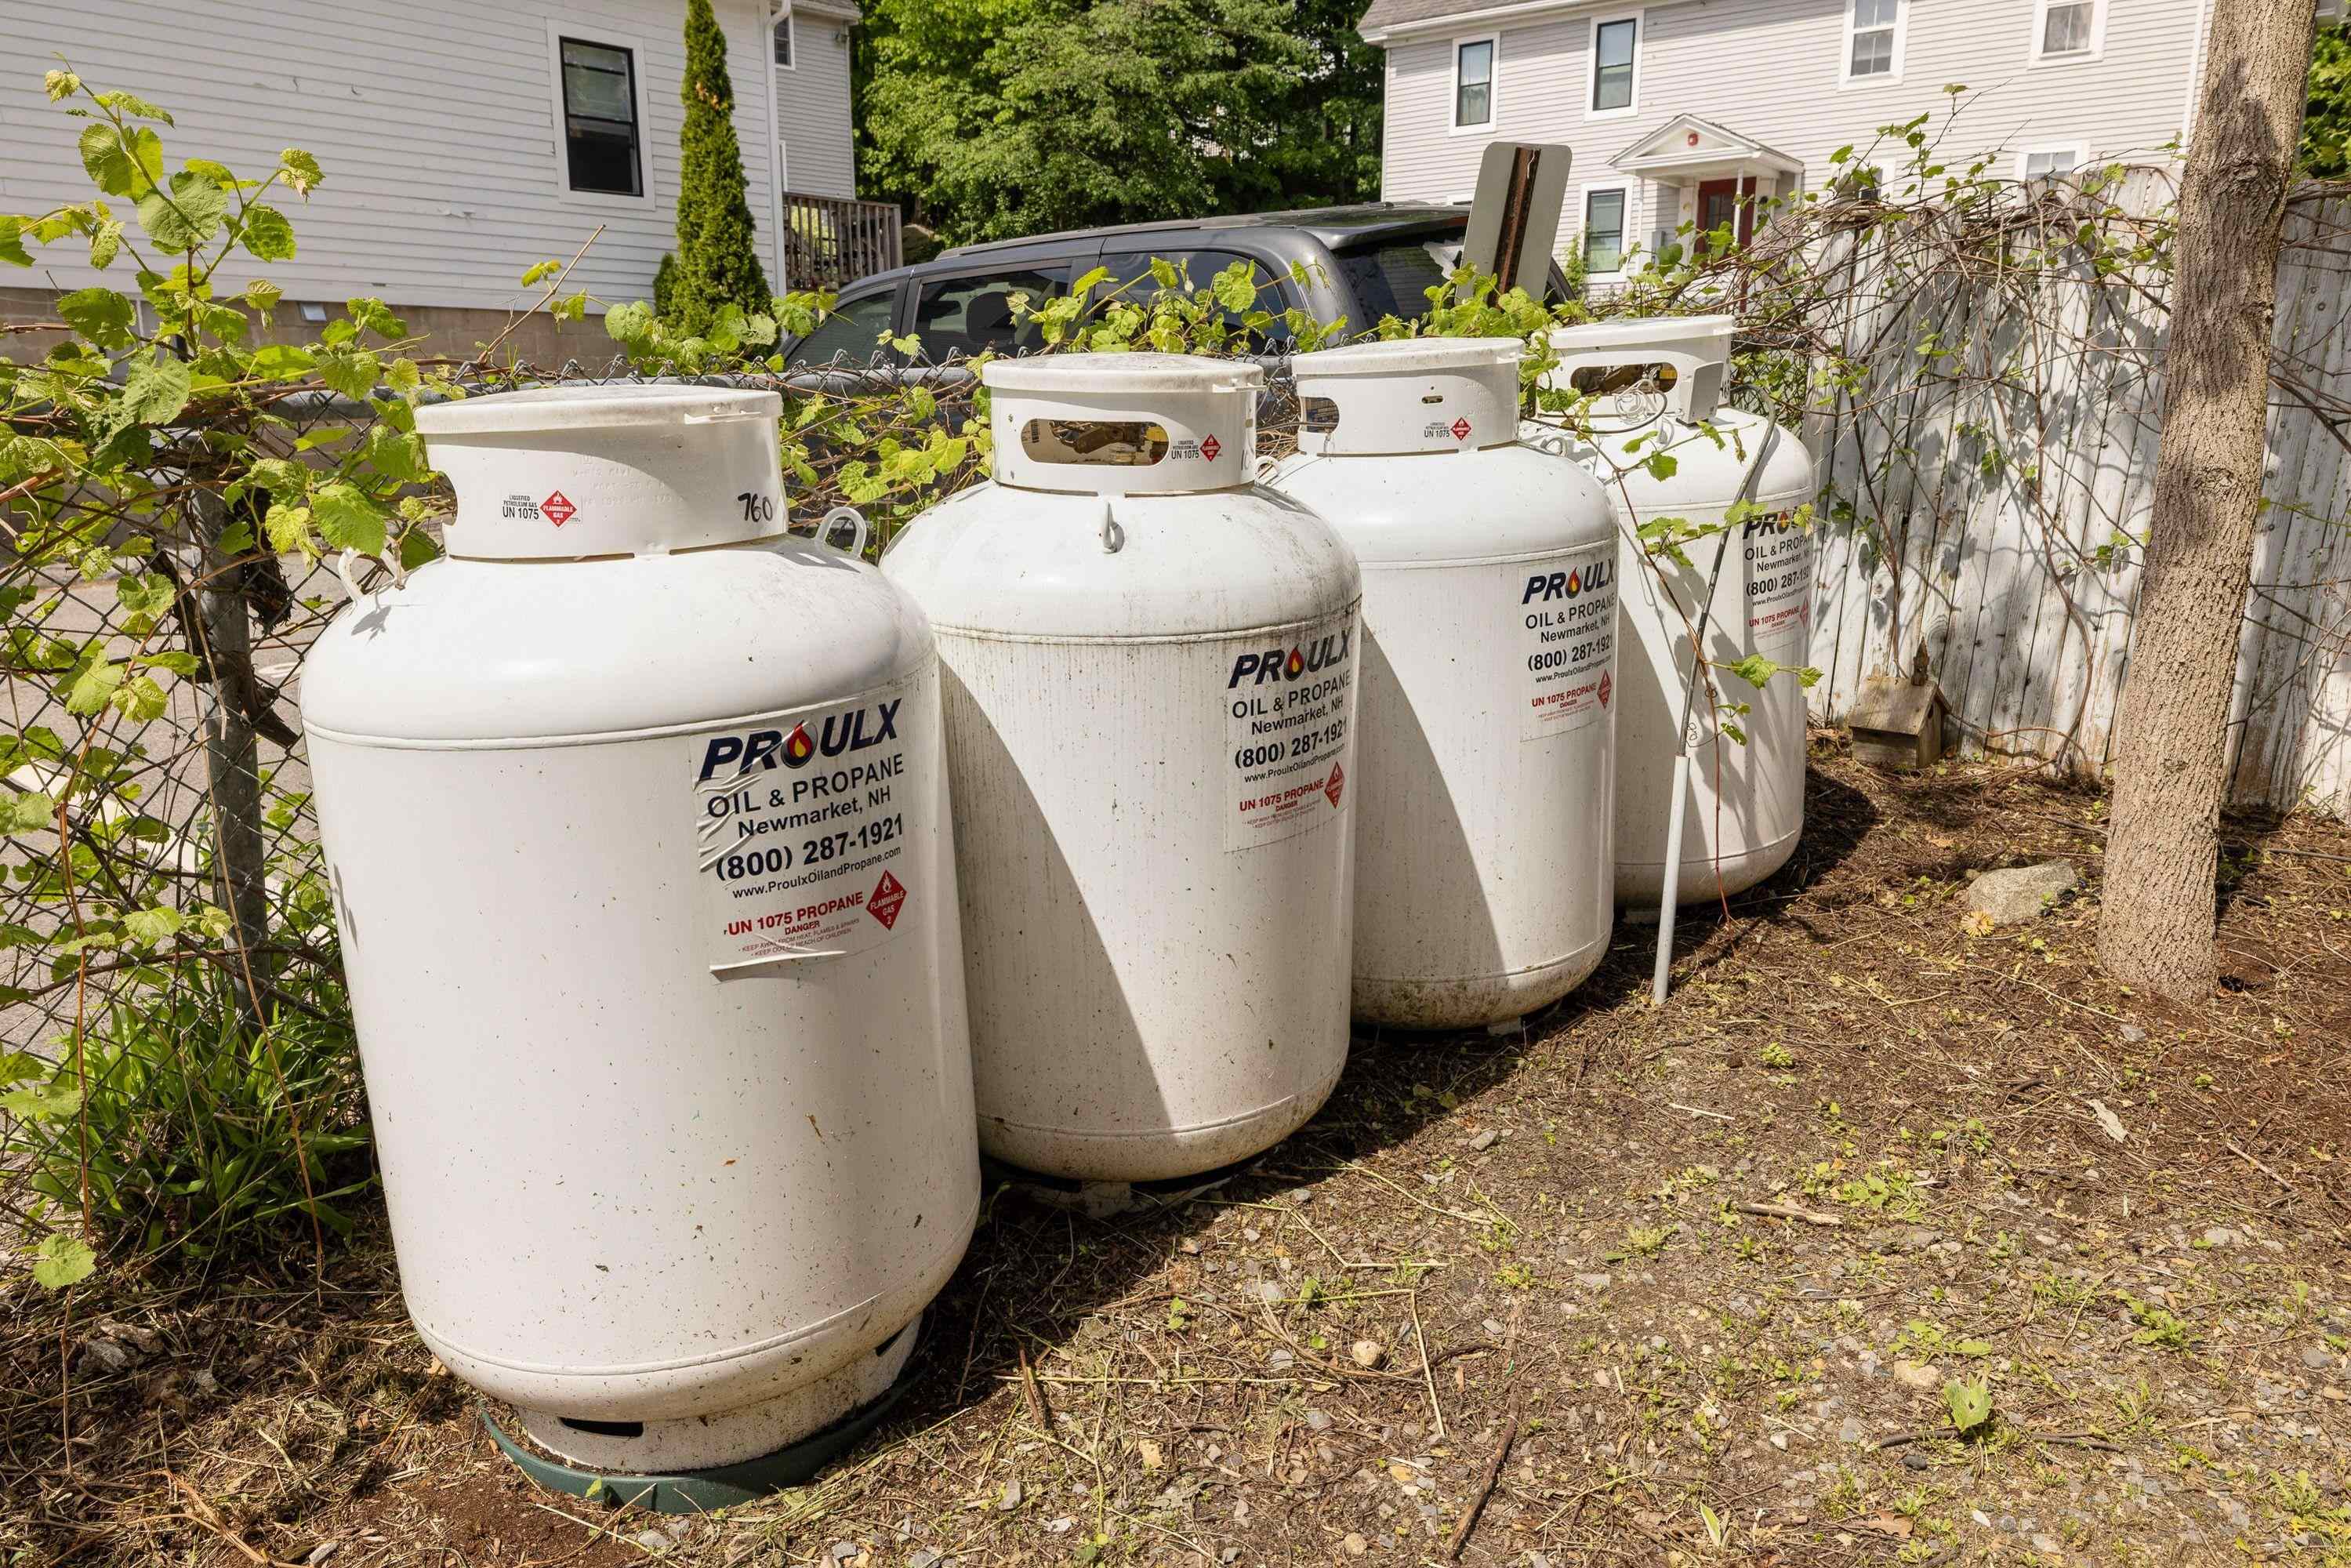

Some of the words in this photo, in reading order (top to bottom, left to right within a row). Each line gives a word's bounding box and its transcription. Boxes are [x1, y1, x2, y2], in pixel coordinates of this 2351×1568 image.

[1424, 430, 1434, 438] UN
[1435, 430, 1450, 438] 1075
[1171, 450, 1182, 459] UN
[1184, 449, 1199, 459] 1075
[502, 506, 515, 518] UN
[517, 507, 539, 521] 1075
[738, 492, 773, 522] 760
[1744, 545, 1768, 561] OIL
[1769, 545, 1776, 557] &
[1522, 557, 1616, 605] PROULX
[1746, 576, 1778, 597] (800)
[1526, 612, 1554, 630] OIL
[1557, 612, 1566, 624] &
[1569, 592, 1616, 622] PROPANE
[1749, 618, 1760, 628] UN
[1761, 614, 1776, 625] 1075
[1540, 620, 1599, 644] Newmarket,
[1601, 615, 1610, 628] NH
[1228, 626, 1353, 689] PROULX
[1528, 648, 1567, 672] (800)
[1571, 631, 1613, 662] 287-1921
[1232, 698, 1268, 719] OIL
[1273, 696, 1284, 712] &
[1288, 669, 1353, 709] PROPANE
[1532, 696, 1545, 707] UN
[1547, 692, 1566, 705] 1075
[1566, 682, 1597, 699] PROPANE
[1250, 703, 1329, 735] Newmarket,
[1331, 695, 1344, 713] NH
[697, 698, 902, 782] PROULX
[1235, 742, 1286, 769] (800)
[1290, 716, 1348, 757] 287-1921
[707, 789, 762, 818] OIL
[768, 789, 786, 809] &
[793, 753, 905, 804] PROPANE
[1239, 799, 1256, 811] UN
[1257, 793, 1283, 808] 1075
[1283, 778, 1325, 801] PROPANE
[738, 795, 864, 840] Newmarket,
[868, 785, 892, 809] NH
[715, 845, 793, 882] (800)
[803, 812, 904, 866] 287-1921
[731, 844, 902, 899] www.ProulxOilandPropane.com
[727, 919, 753, 936] UN
[756, 911, 793, 930] 1075
[796, 891, 864, 922] PROPANE
[784, 920, 821, 935] DANGER
[883, 904, 895, 916] GAS
[886, 916, 892, 925] 2
